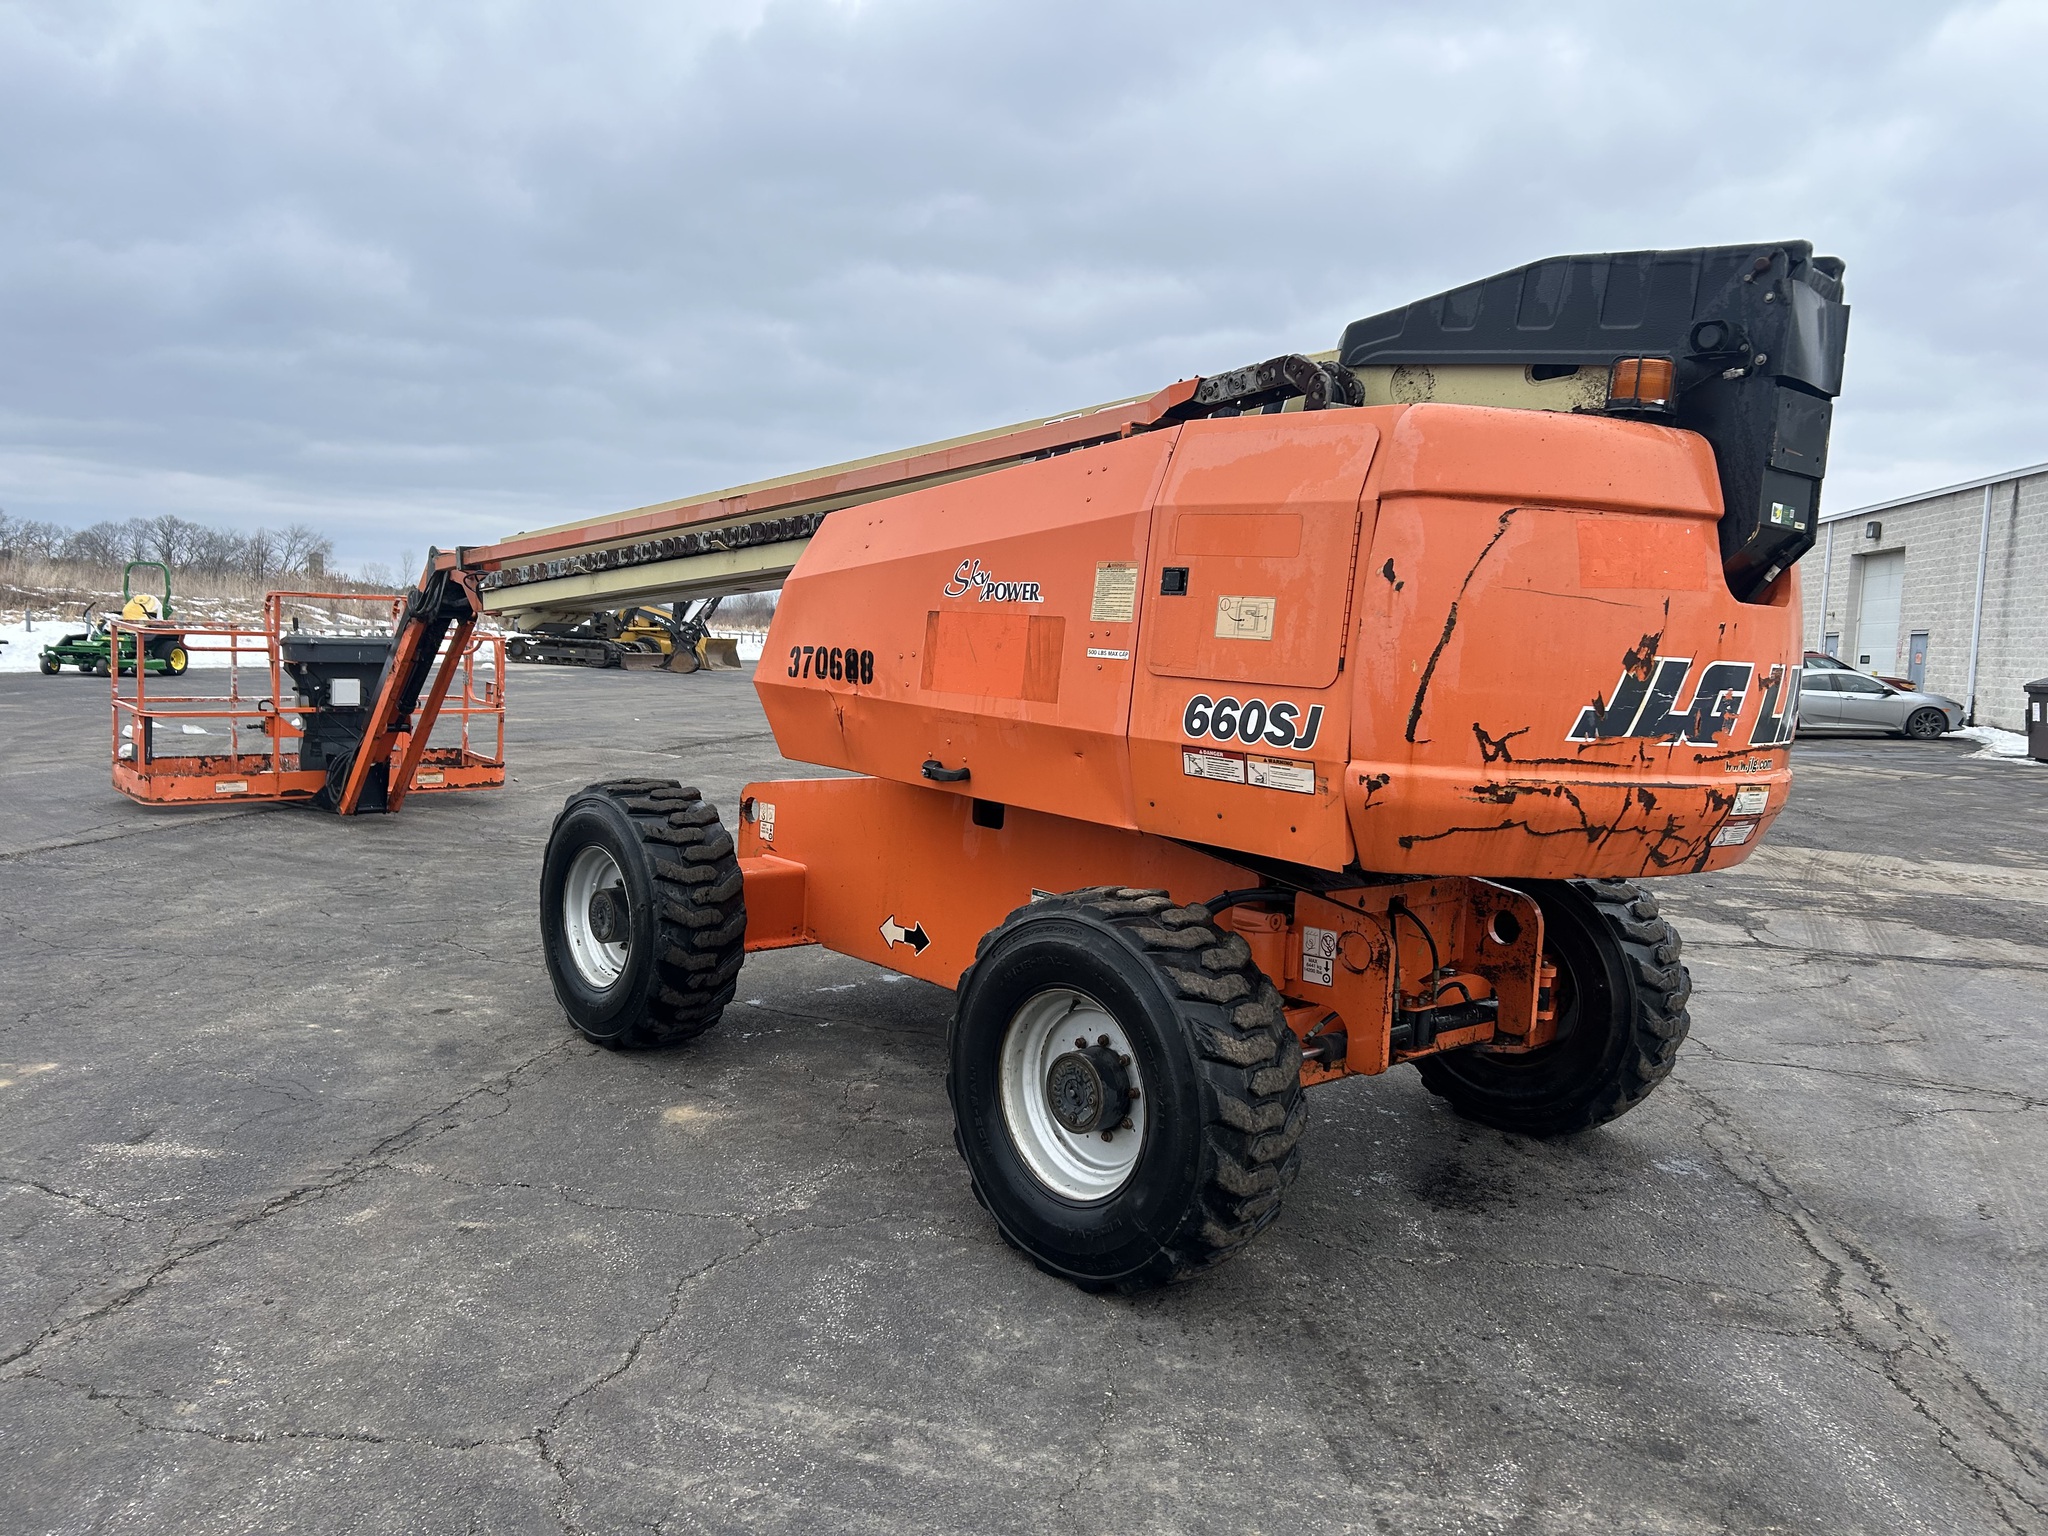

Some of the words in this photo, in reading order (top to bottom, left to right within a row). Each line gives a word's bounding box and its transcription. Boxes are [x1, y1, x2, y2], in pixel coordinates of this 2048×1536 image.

[944, 558, 991, 602] Sky
[986, 581, 1042, 603] POWER
[1566, 657, 1755, 746] JLG
[1184, 694, 1324, 750] 660SJ
[1203, 750, 1224, 758] DANGER
[1267, 758, 1293, 767] WARNING
[1725, 756, 1773, 774] www.jlg.com
